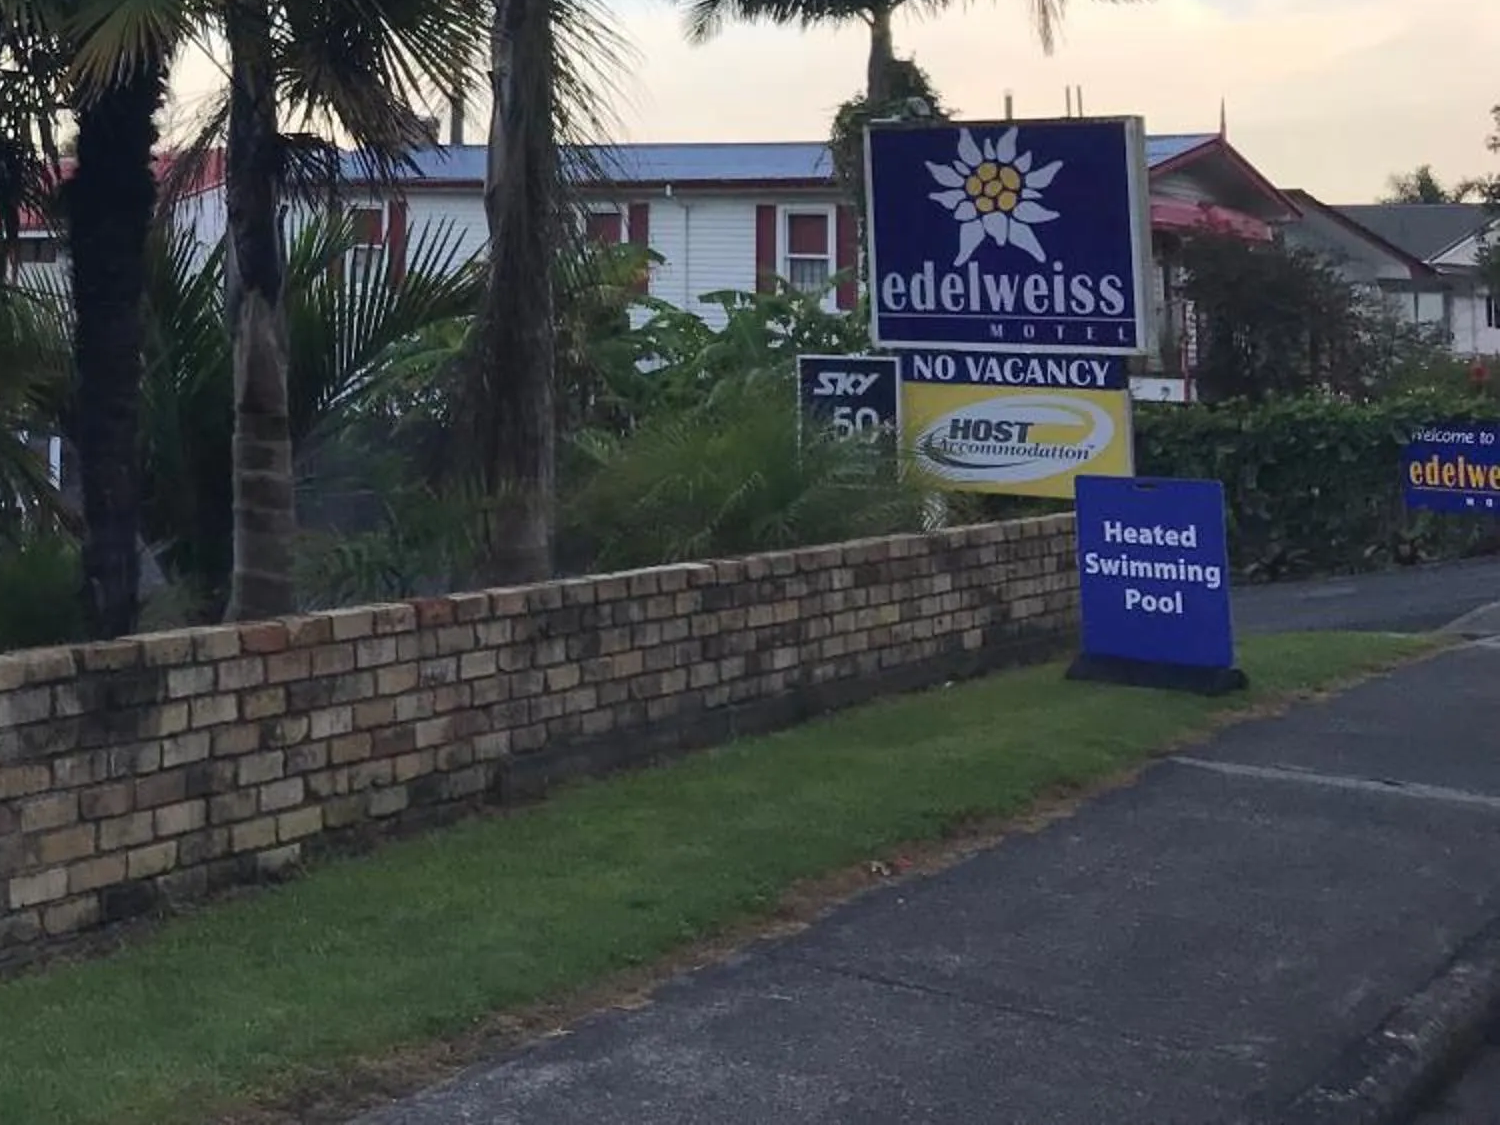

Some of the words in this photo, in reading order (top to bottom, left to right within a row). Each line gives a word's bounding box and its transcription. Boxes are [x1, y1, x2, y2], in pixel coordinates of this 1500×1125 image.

[882, 261, 1125, 315] edelweiss
[989, 324, 1128, 340] MOTEL
[913, 354, 956, 379] NO
[966, 356, 1110, 386] VACANCY
[813, 372, 879, 395] SKY
[949, 418, 1035, 443] HOST
[1479, 431, 1495, 444] to
[1104, 520, 1197, 548] Heated
[1085, 552, 1221, 588] Swimming
[1125, 588, 1183, 614] Pool
